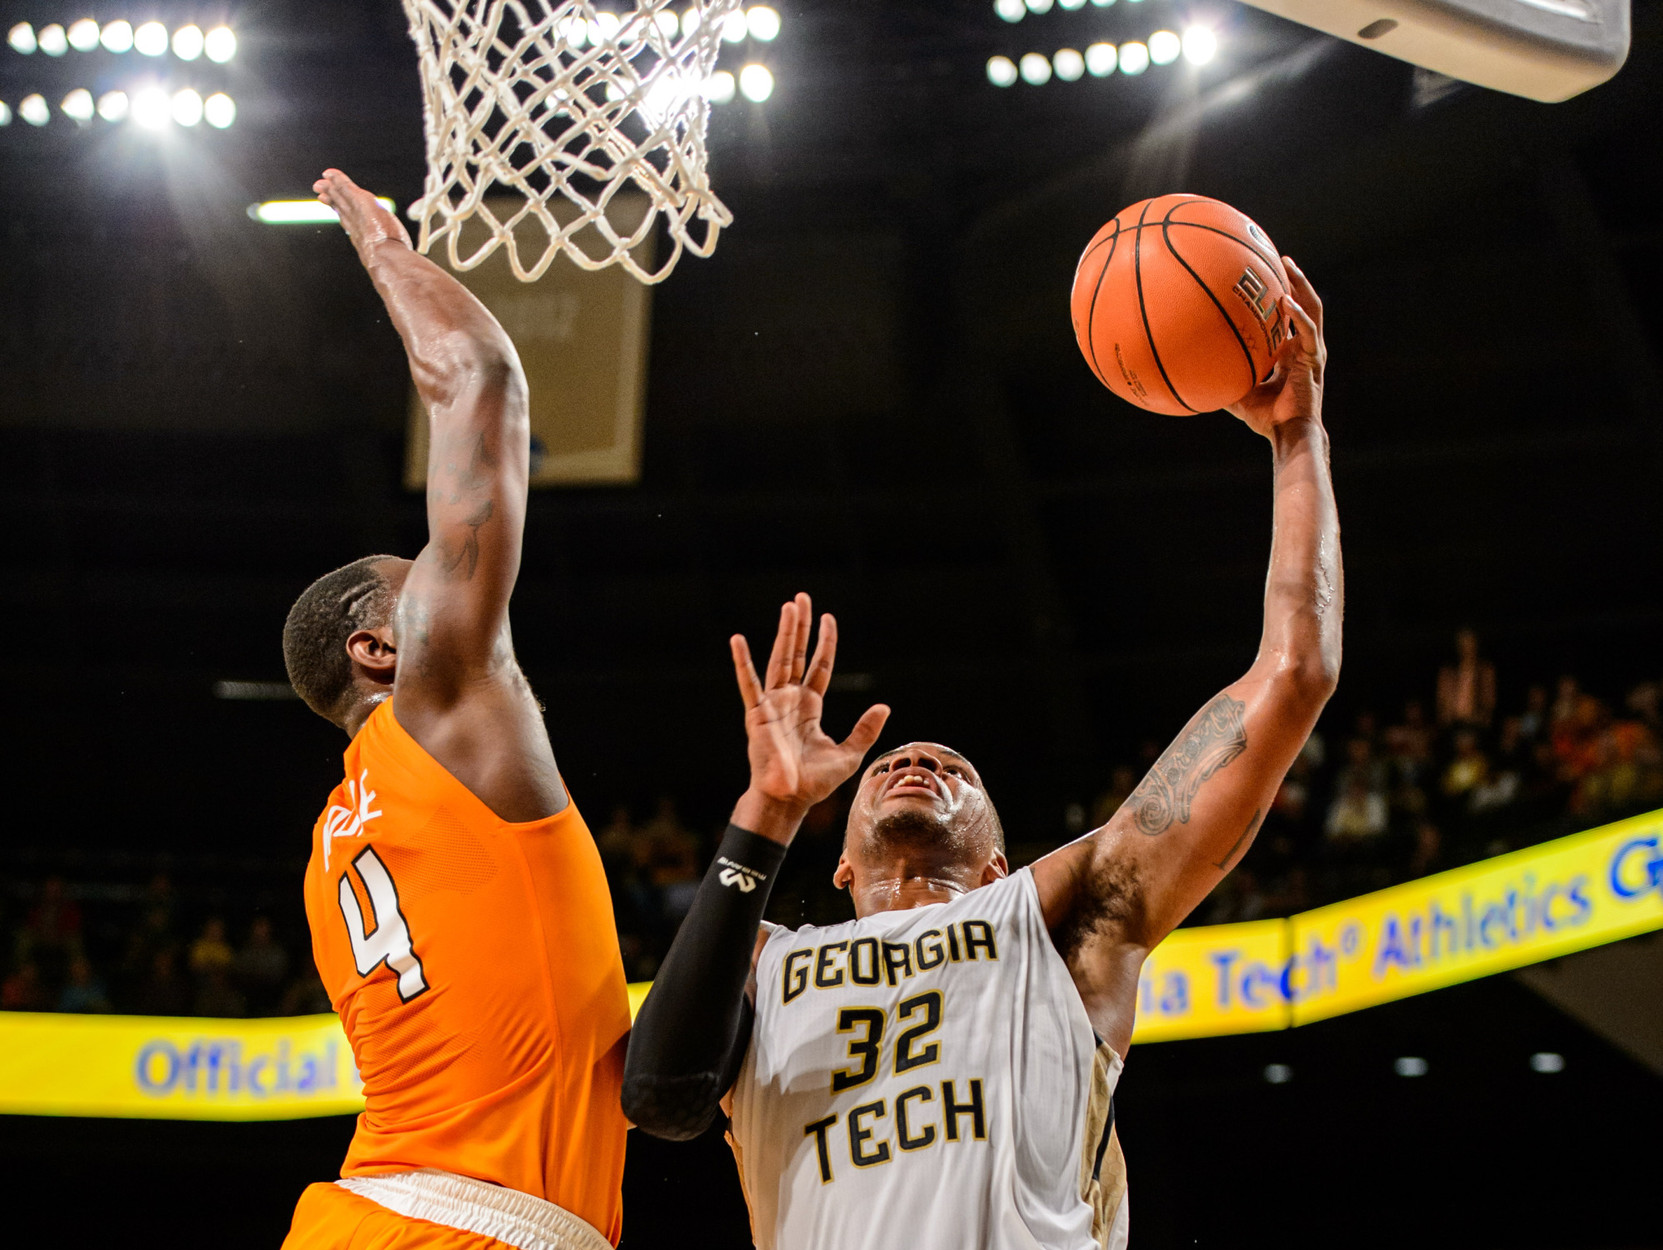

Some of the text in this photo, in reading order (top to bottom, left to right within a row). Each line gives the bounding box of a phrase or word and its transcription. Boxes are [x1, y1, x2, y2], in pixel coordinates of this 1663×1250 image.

[338, 843, 430, 1005] 4
[782, 919, 998, 1005] GEORGIA
[1373, 872, 1592, 980] Athletics
[136, 1037, 338, 1098] Official
[830, 989, 944, 1095] 32
[804, 1079, 988, 1185] TECH
